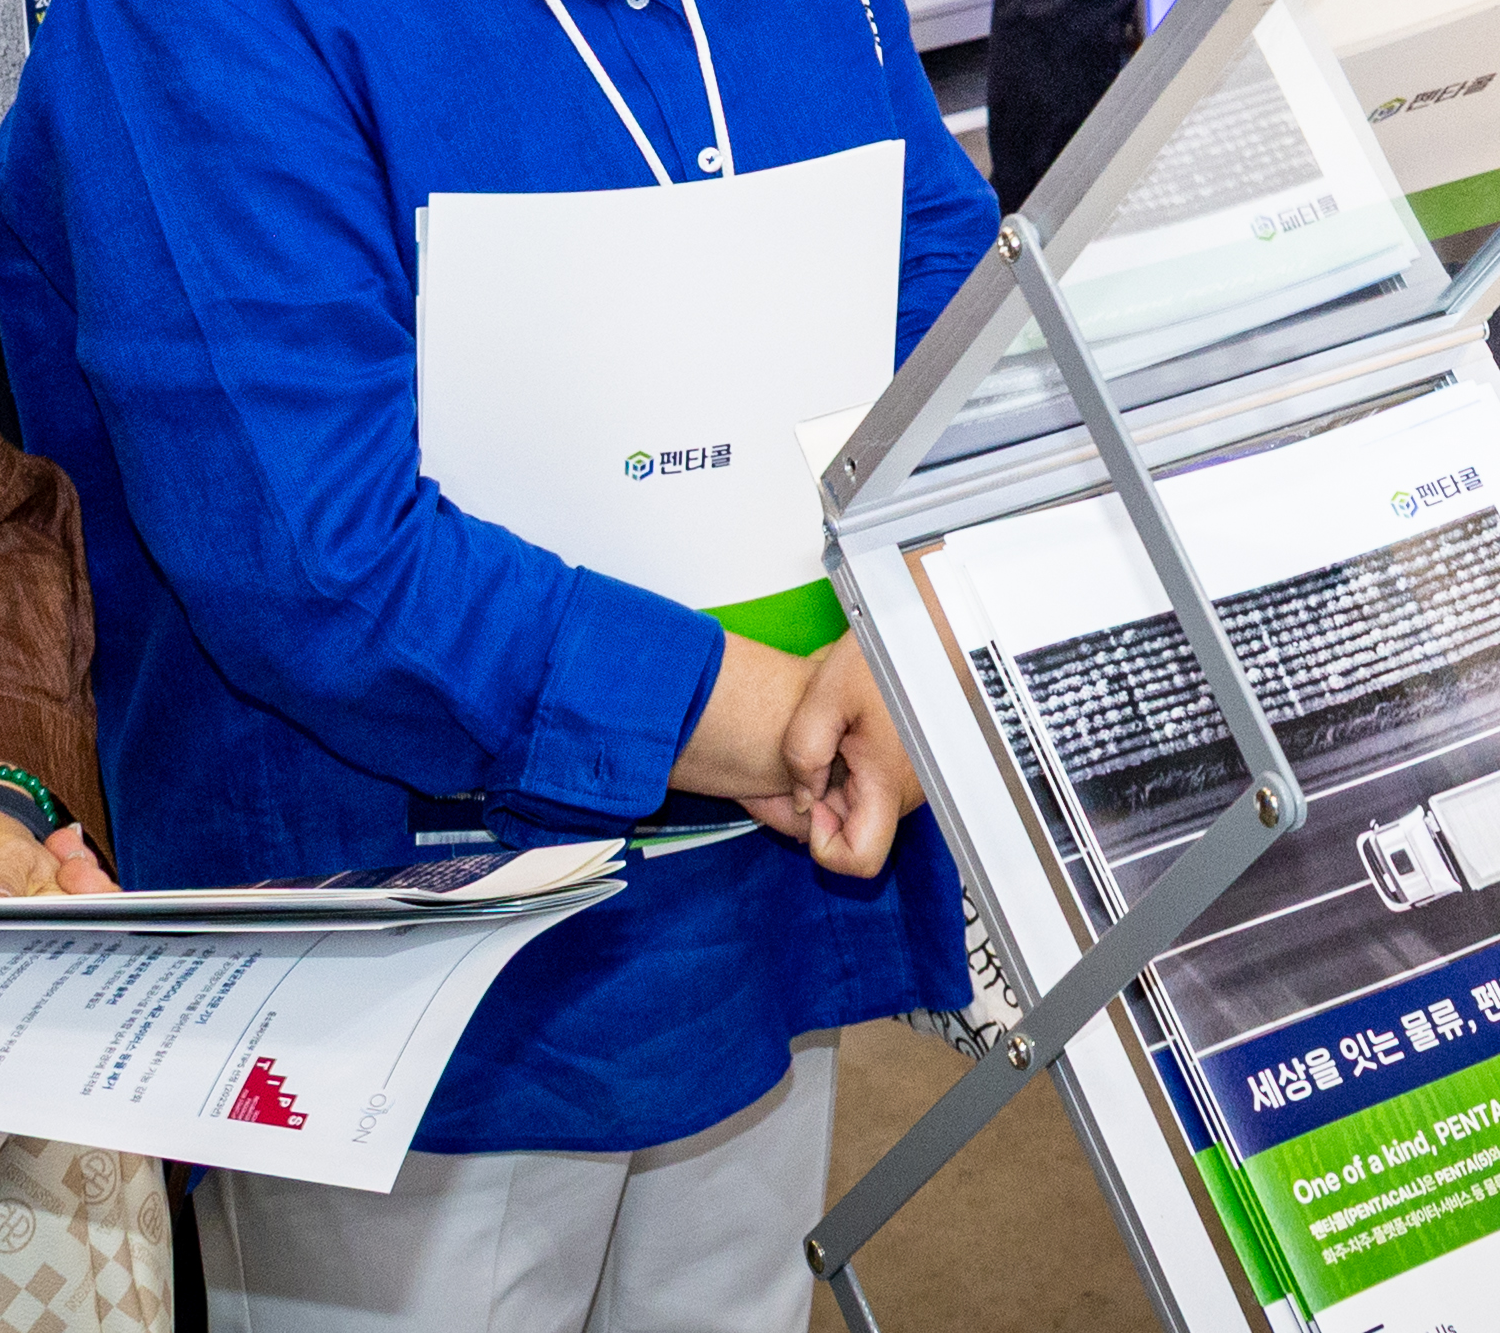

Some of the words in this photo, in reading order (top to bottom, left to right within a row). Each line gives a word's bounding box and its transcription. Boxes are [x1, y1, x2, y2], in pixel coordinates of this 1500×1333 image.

[1405, 72, 1497, 112] 펜타콜
[658, 442, 732, 476] 펜타콜
[1415, 465, 1486, 510] 펜타콜
[1246, 1046, 1344, 1112] 세상을
[1340, 1030, 1405, 1077] 잇는
[1400, 998, 1478, 1053] 물류,
[256, 1060, 304, 1126] TIPS
[1292, 1171, 1341, 1205] One
[1343, 1160, 1365, 1186] of
[1368, 1157, 1383, 1176] a
[1382, 1129, 1438, 1169] kind,
[1472, 1181, 1486, 1202] 등
[1309, 1173, 1437, 1240] 펜타콜(PENTACALL)은
